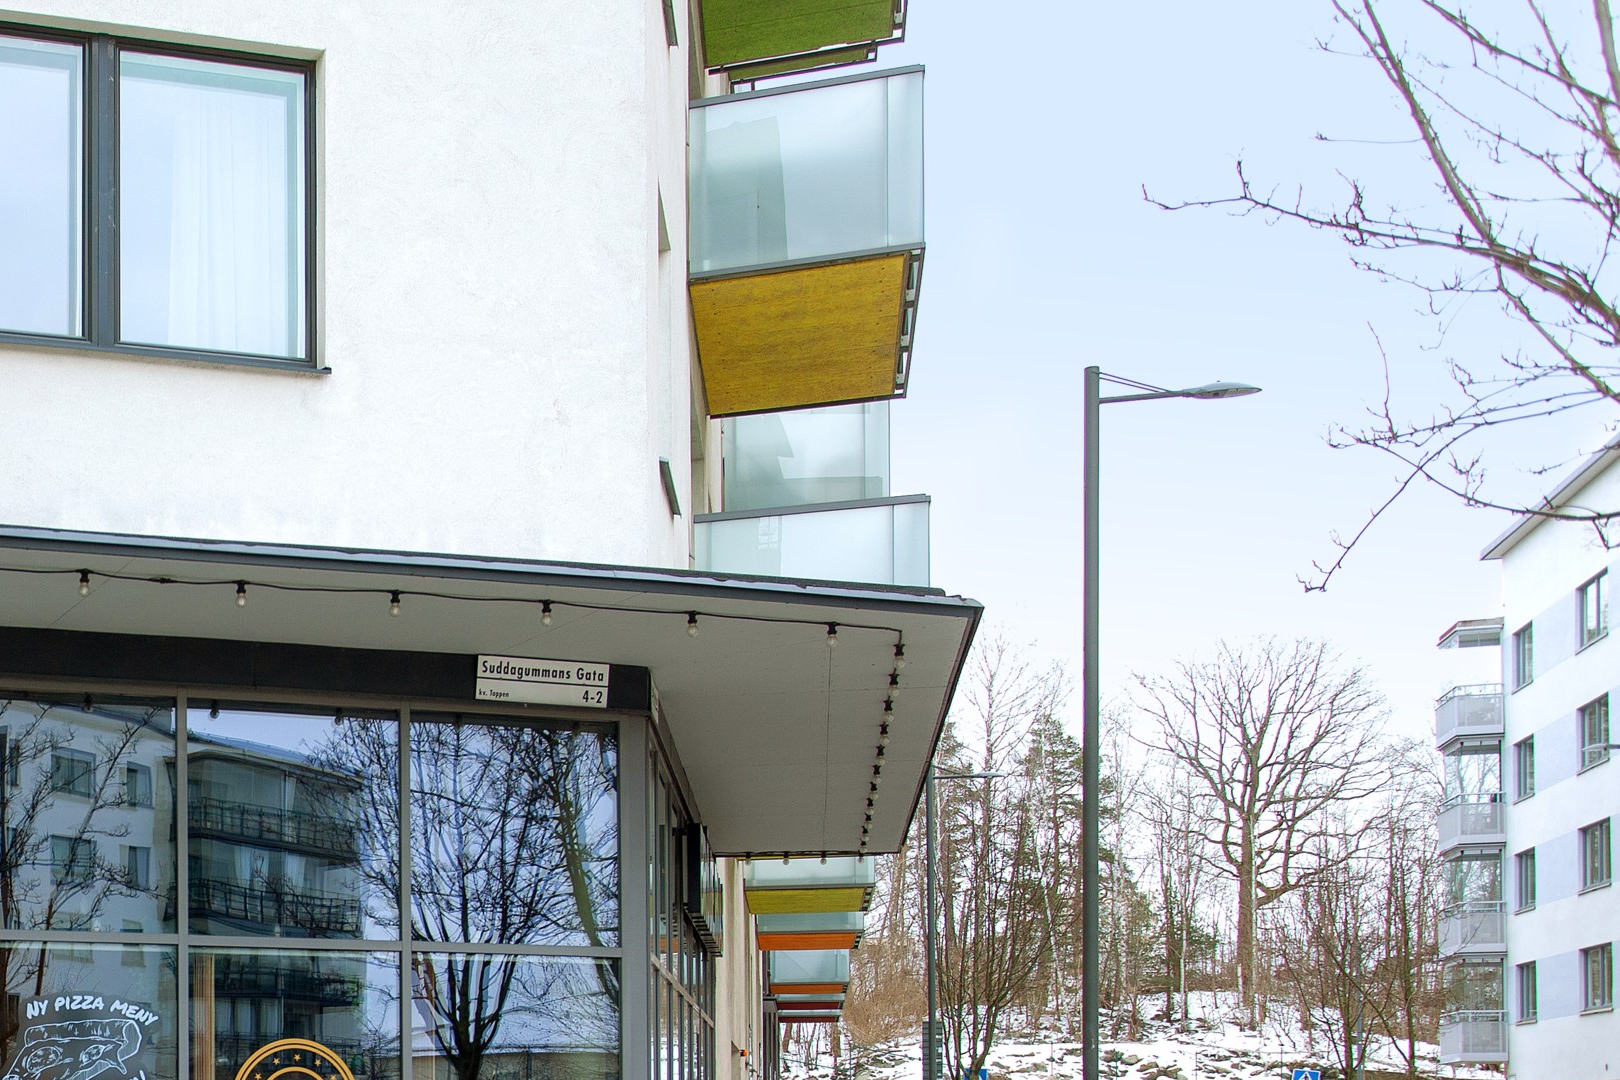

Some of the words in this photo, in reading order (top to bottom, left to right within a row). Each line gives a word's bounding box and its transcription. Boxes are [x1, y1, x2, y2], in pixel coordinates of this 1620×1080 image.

[482, 660, 571, 680] Suddagummans
[576, 668, 604, 682] Gata
[582, 690, 603, 704] 4-2
[26, 998, 48, 1019] NY
[54, 995, 104, 1012] PIZZA
[109, 999, 159, 1027] MENY
